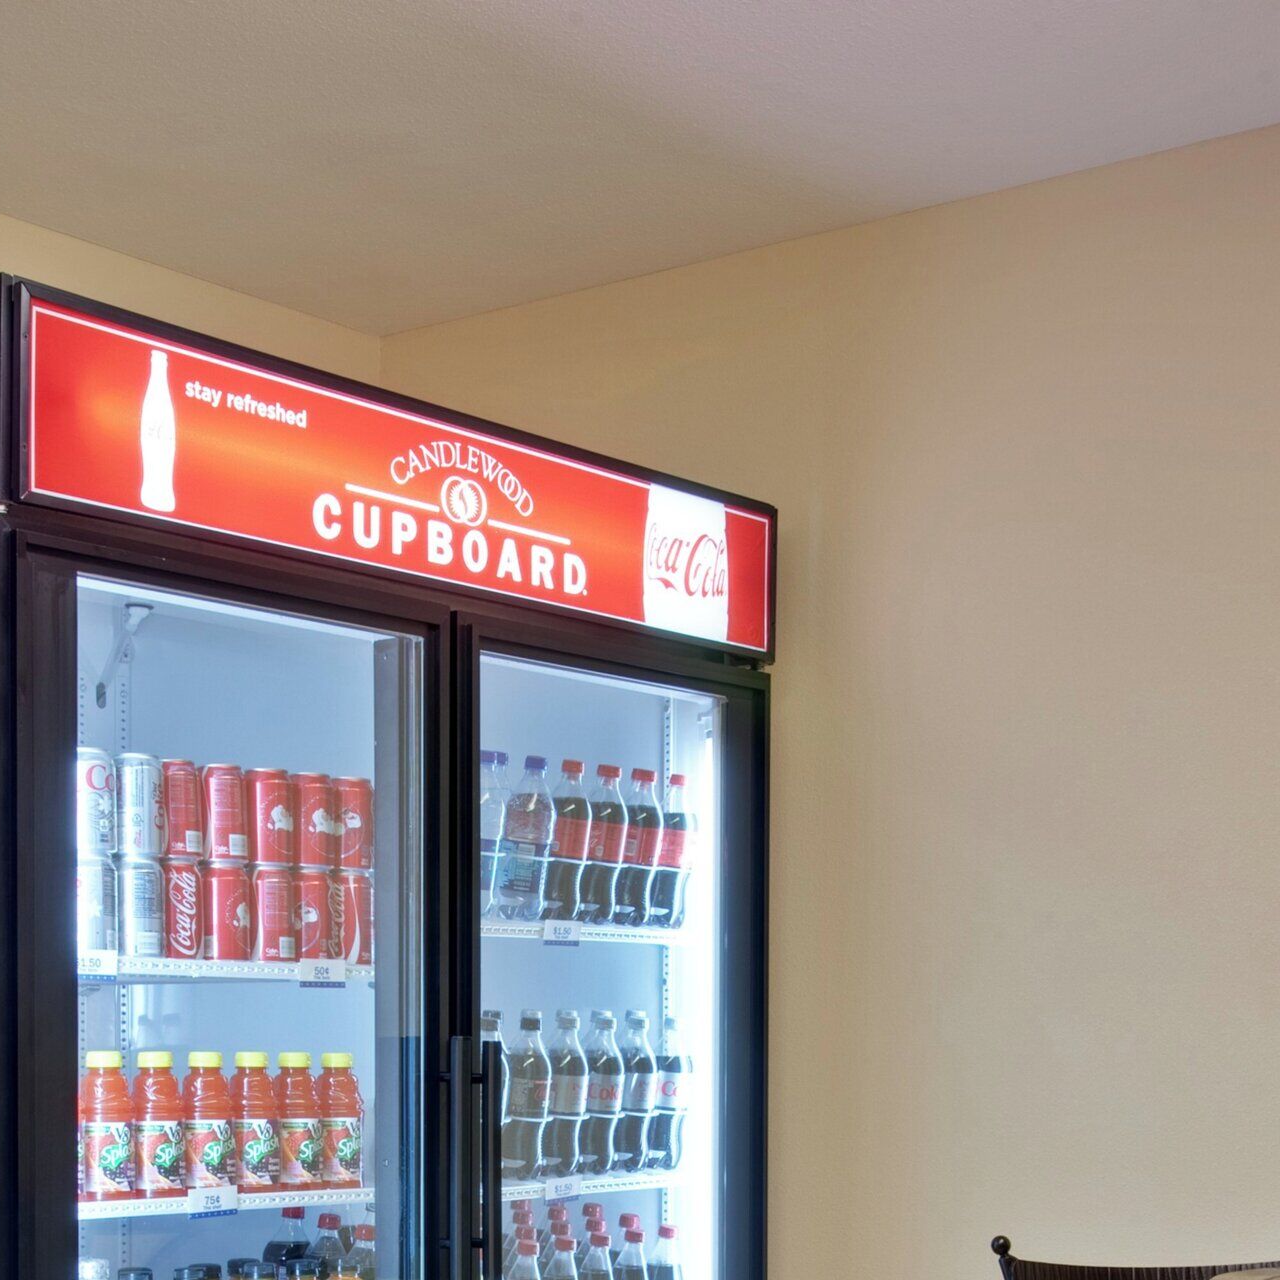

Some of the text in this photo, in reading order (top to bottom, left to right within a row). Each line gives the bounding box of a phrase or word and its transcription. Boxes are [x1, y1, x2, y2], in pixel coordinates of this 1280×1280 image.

[185, 380, 307, 429] stay refreshed
[390, 440, 534, 517] CANDLEWOOD
[312, 493, 588, 596] CUPBOARD
[646, 522, 726, 598] Coca-Cola
[169, 867, 197, 956] Coca-Cola
[588, 1081, 620, 1101] Cok
[204, 1195, 220, 1205] 75¢
